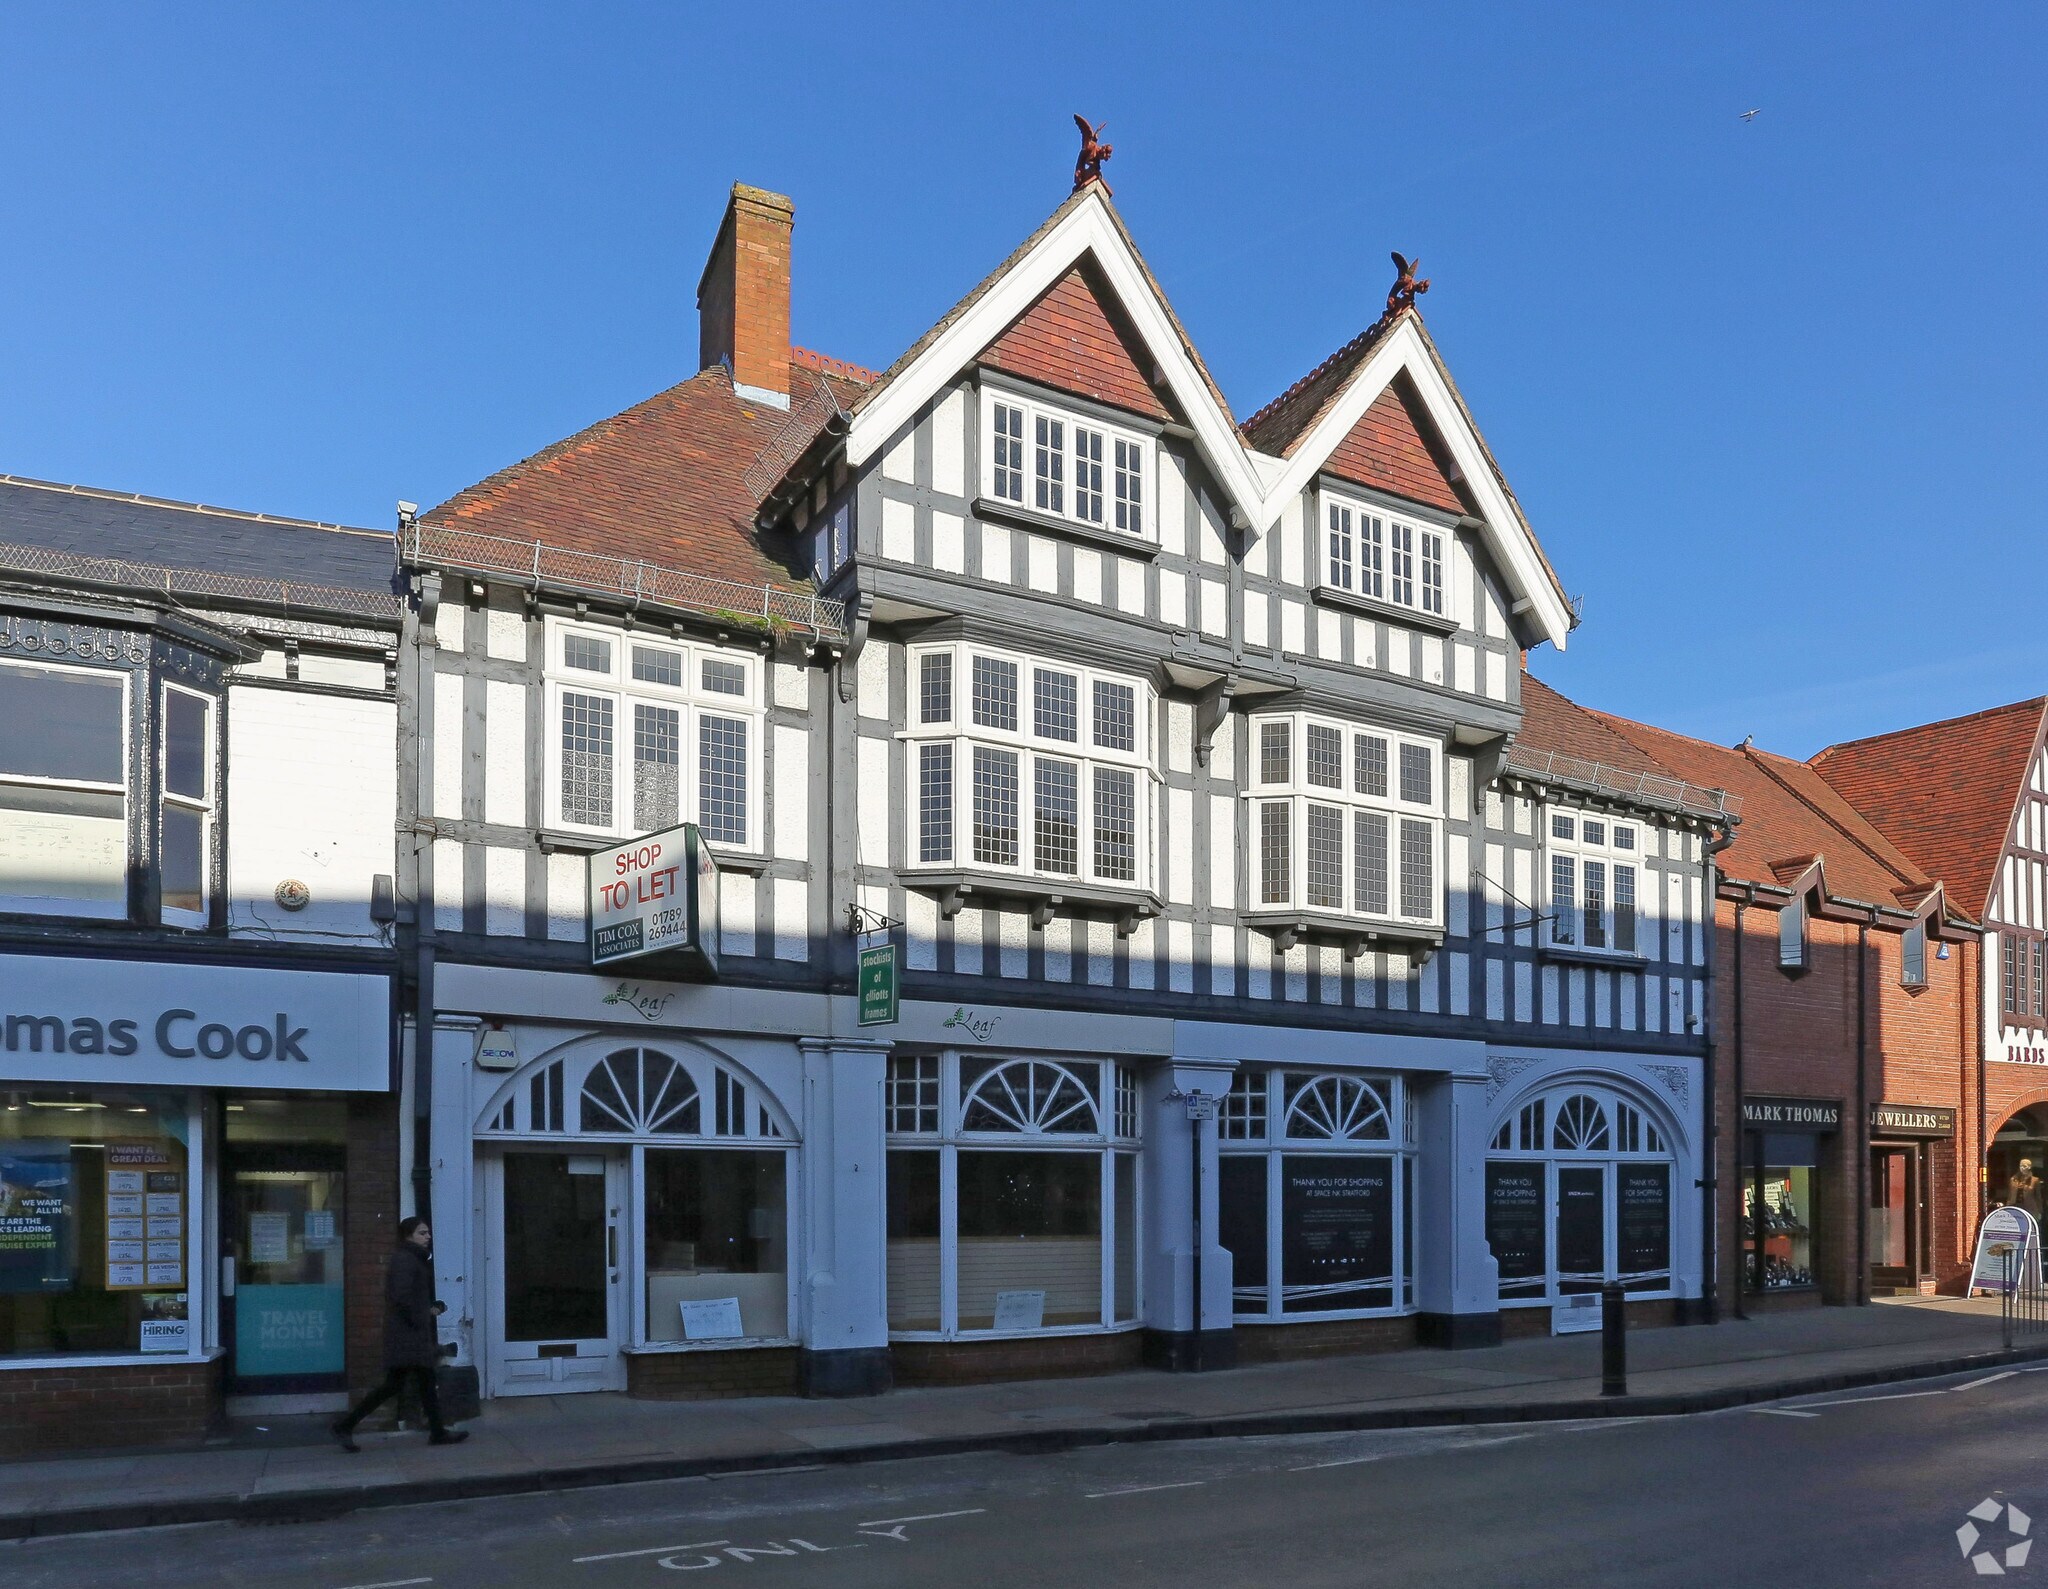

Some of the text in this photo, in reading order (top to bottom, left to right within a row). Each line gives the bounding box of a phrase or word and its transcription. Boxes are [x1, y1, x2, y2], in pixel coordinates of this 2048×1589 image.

[616, 844, 662, 875] SHOP
[600, 880, 630, 912] TO
[638, 866, 680, 904] LET
[652, 908, 682, 926] 01789
[598, 922, 639, 944] TIM COX
[648, 920, 686, 940] 269444
[598, 938, 640, 956] ASSOCIATES
[864, 952, 891, 967] stockists
[874, 970, 882, 983] of
[619, 987, 675, 1021] Leaf
[865, 1008, 887, 1019] frames
[0, 1008, 309, 1062] mas Cook
[956, 1011, 1002, 1042] Leaf
[482, 1049, 514, 1058] SECOM
[2008, 1046, 2044, 1064] BARDS
[1743, 1105, 1838, 1123] MARK THOMAS
[1870, 1112, 1936, 1128] JEWELLERS
[1292, 1178, 1315, 1187] THANK
[1318, 1178, 1332, 1187] YOU
[1349, 1178, 1384, 1187] SHOPPING
[260, 1310, 328, 1325] TRAVEL
[144, 1326, 185, 1335] HIRING
[261, 1326, 326, 1339] MONEY
[658, 1525, 910, 1570] ONLY
